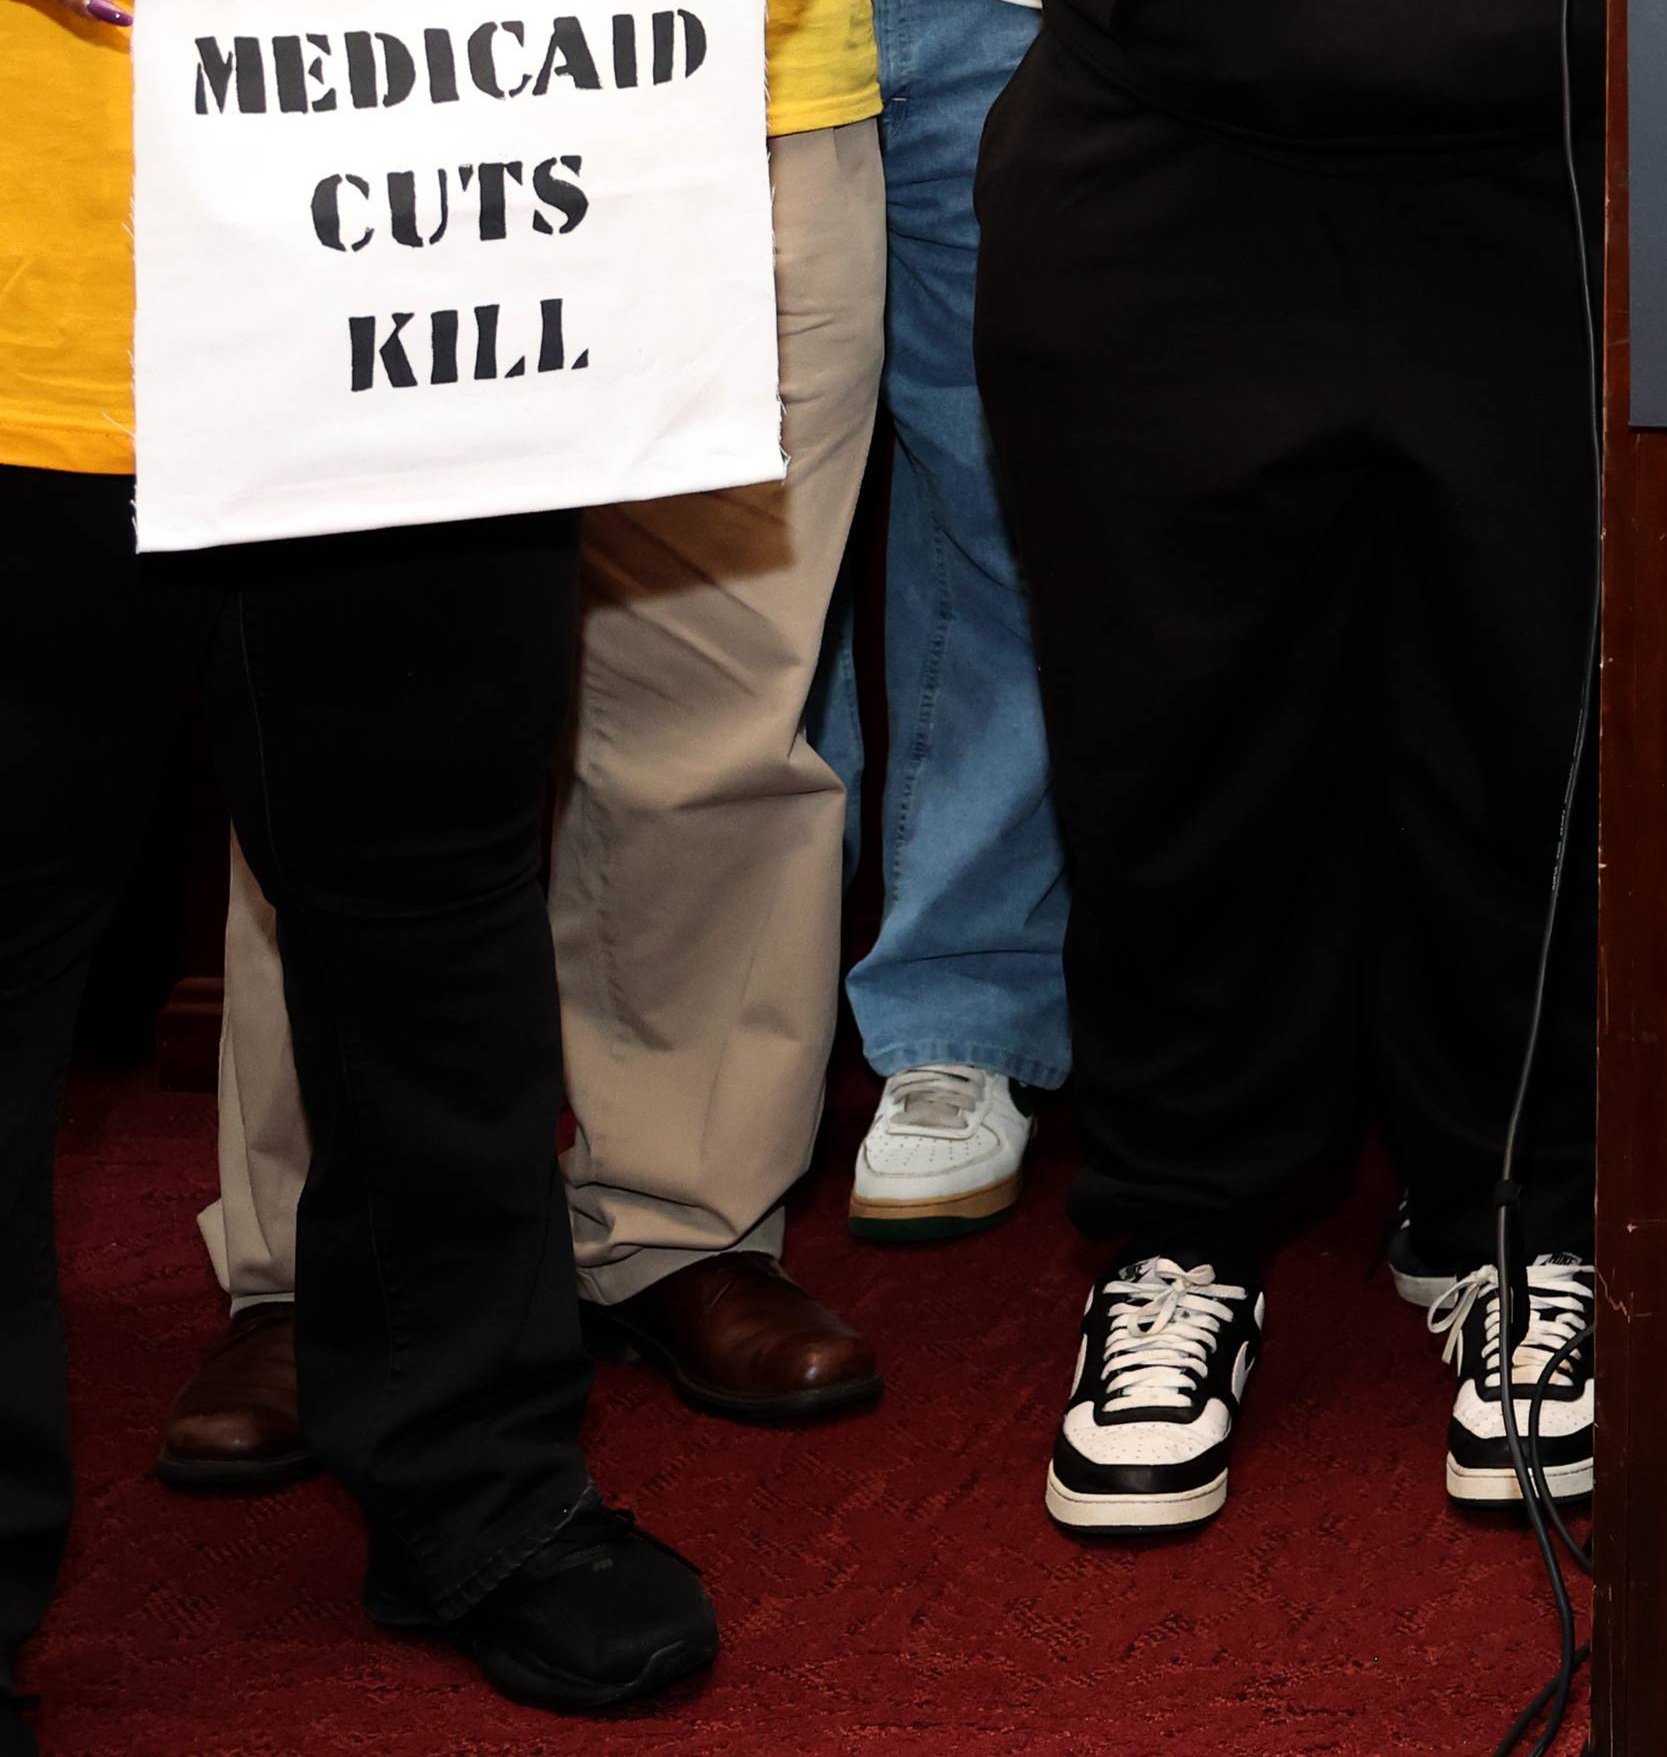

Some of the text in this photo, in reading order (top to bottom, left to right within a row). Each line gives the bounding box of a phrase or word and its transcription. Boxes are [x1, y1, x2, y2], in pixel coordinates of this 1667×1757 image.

[195, 9, 708, 115] MEDICAID
[311, 154, 590, 253] CUTS
[349, 298, 590, 392] KILL
